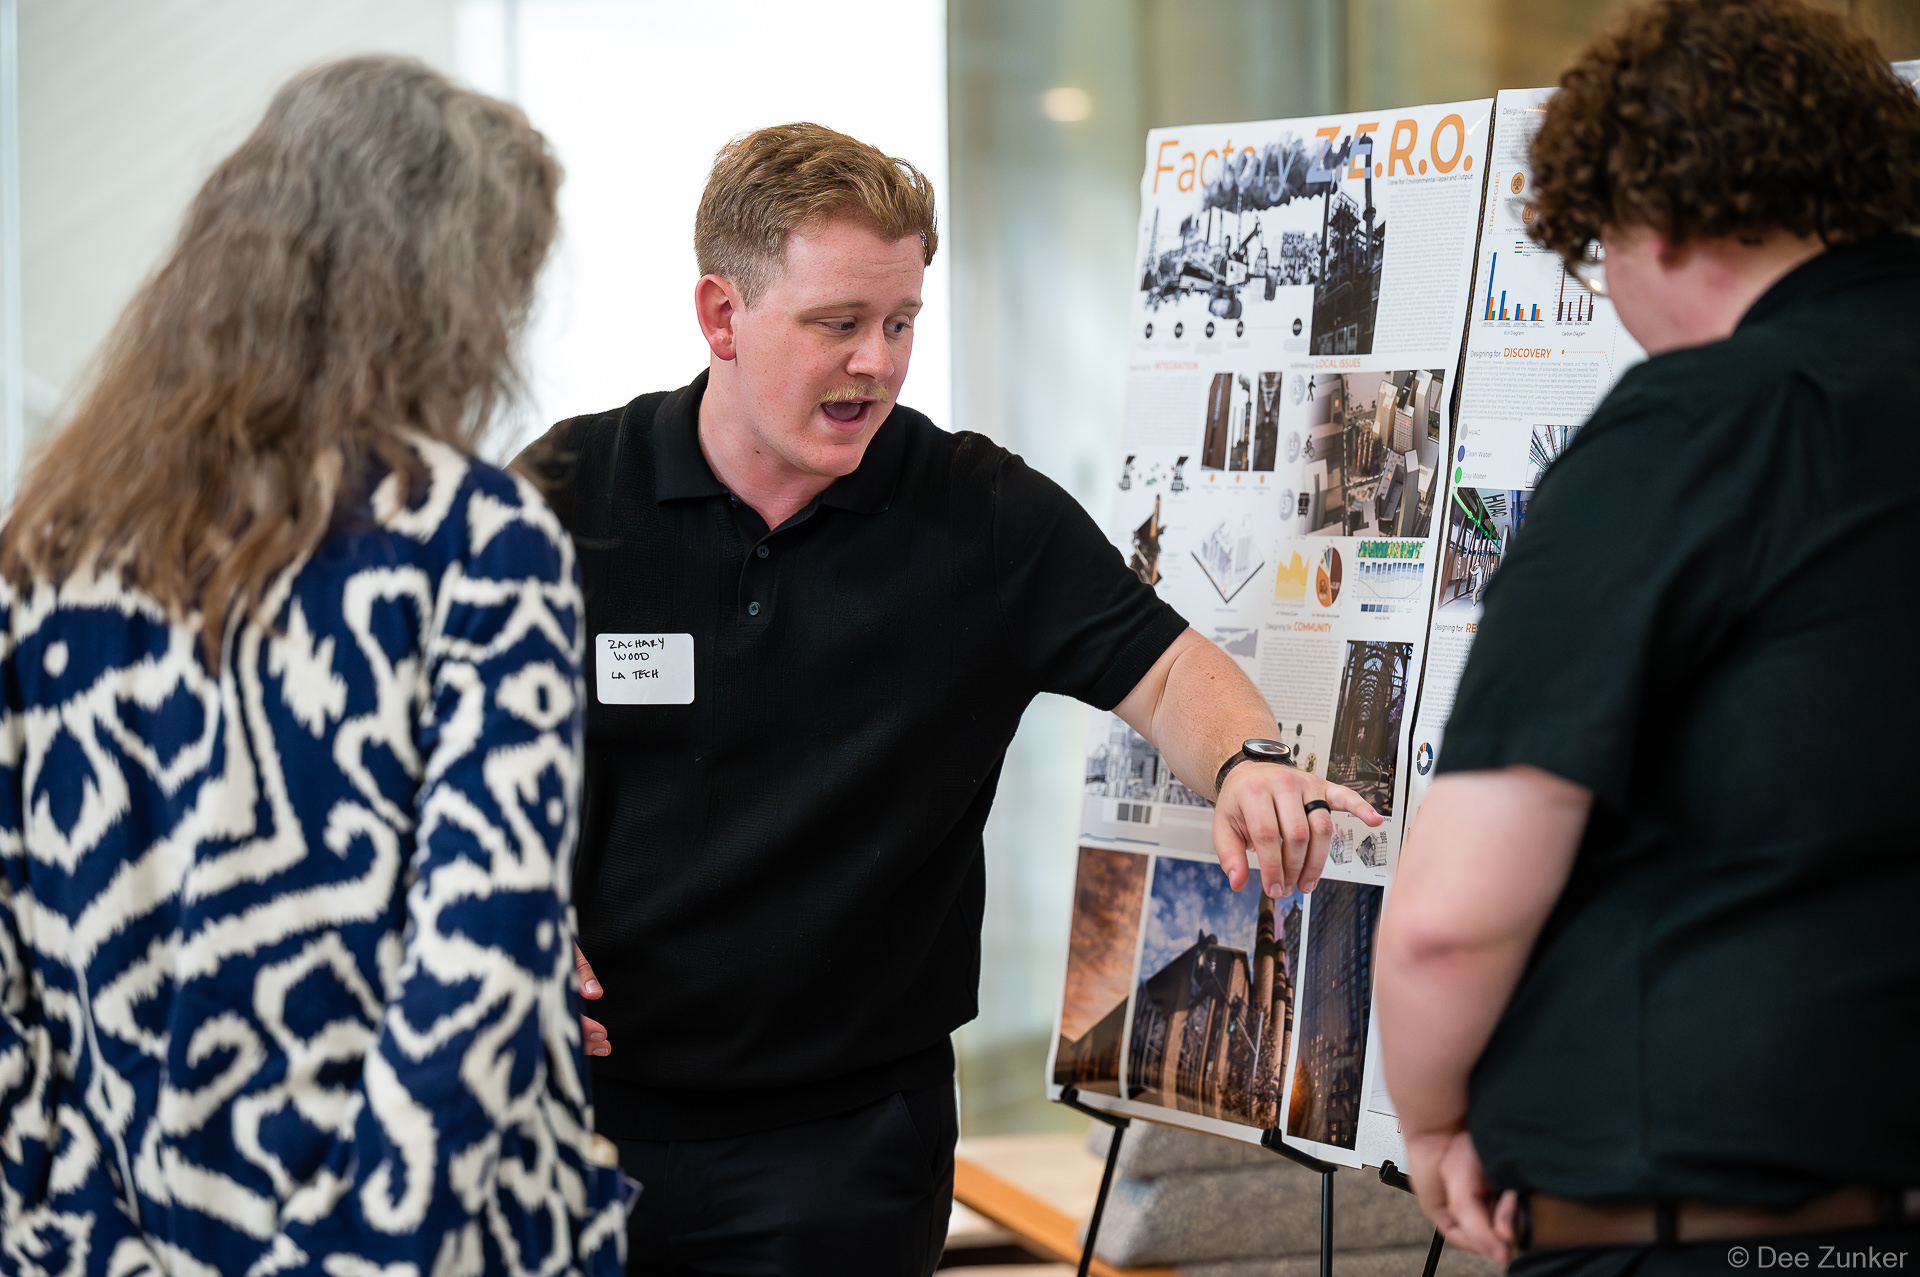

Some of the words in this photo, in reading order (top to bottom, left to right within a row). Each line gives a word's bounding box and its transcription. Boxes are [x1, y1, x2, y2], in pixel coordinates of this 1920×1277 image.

[1153, 140, 1301, 202] Factory
[1306, 114, 1473, 183] Z.E.R.O.
[1470, 350, 1493, 359] Designing
[1493, 350, 1501, 358] for
[1504, 347, 1552, 358] DISCOVERY
[1315, 359, 1337, 369] LOCAL
[1339, 358, 1361, 368] ISSUES
[1483, 494, 1508, 518] HVAC
[1293, 621, 1332, 632] COMMUNITY
[1434, 622, 1456, 634] Designing
[607, 637, 665, 650] ZACHARY
[613, 651, 650, 661] WOOD
[611, 671, 626, 680] LA
[632, 669, 659, 680] TECH
